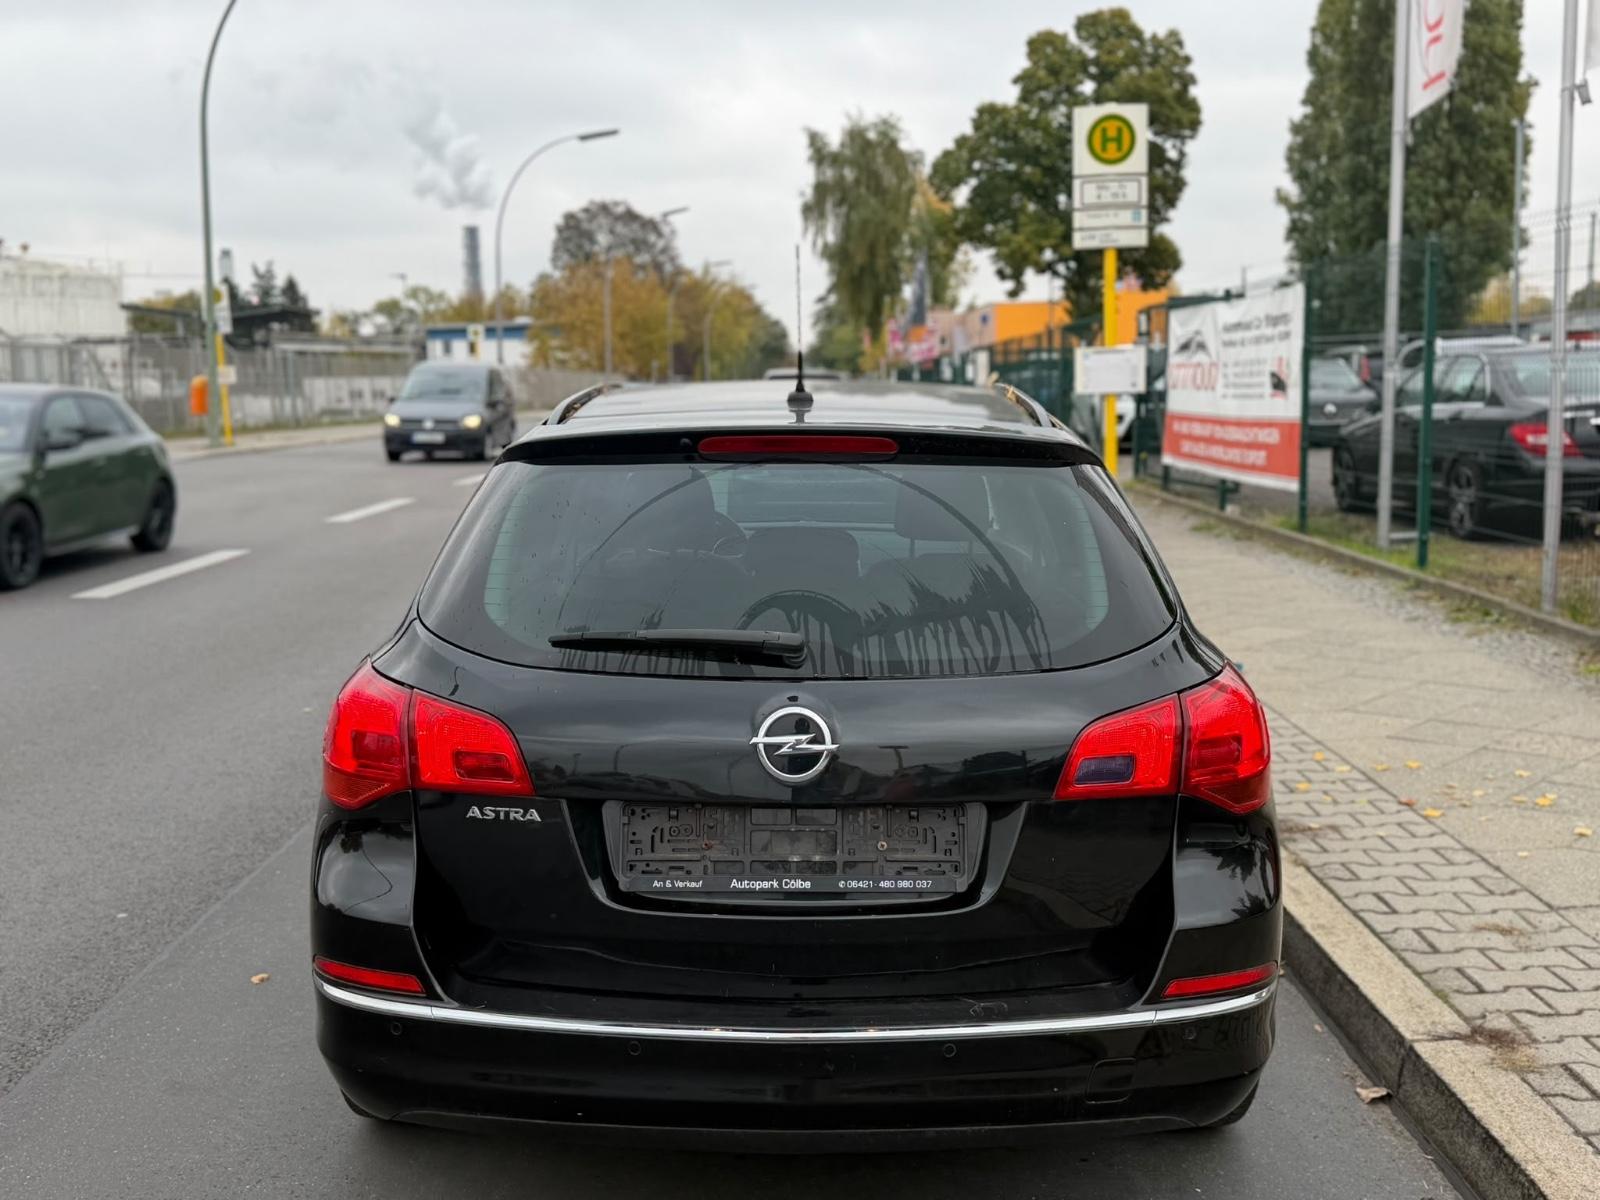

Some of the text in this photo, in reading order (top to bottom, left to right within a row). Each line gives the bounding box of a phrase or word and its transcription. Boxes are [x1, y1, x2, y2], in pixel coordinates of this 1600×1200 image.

[1101, 126, 1124, 153] H
[466, 805, 542, 822] ASTRA
[652, 880, 664, 888] An
[673, 880, 704, 888] Verkauf
[730, 878, 780, 891] Autopark
[846, 880, 873, 888] 06421
[915, 880, 932, 888] 037
